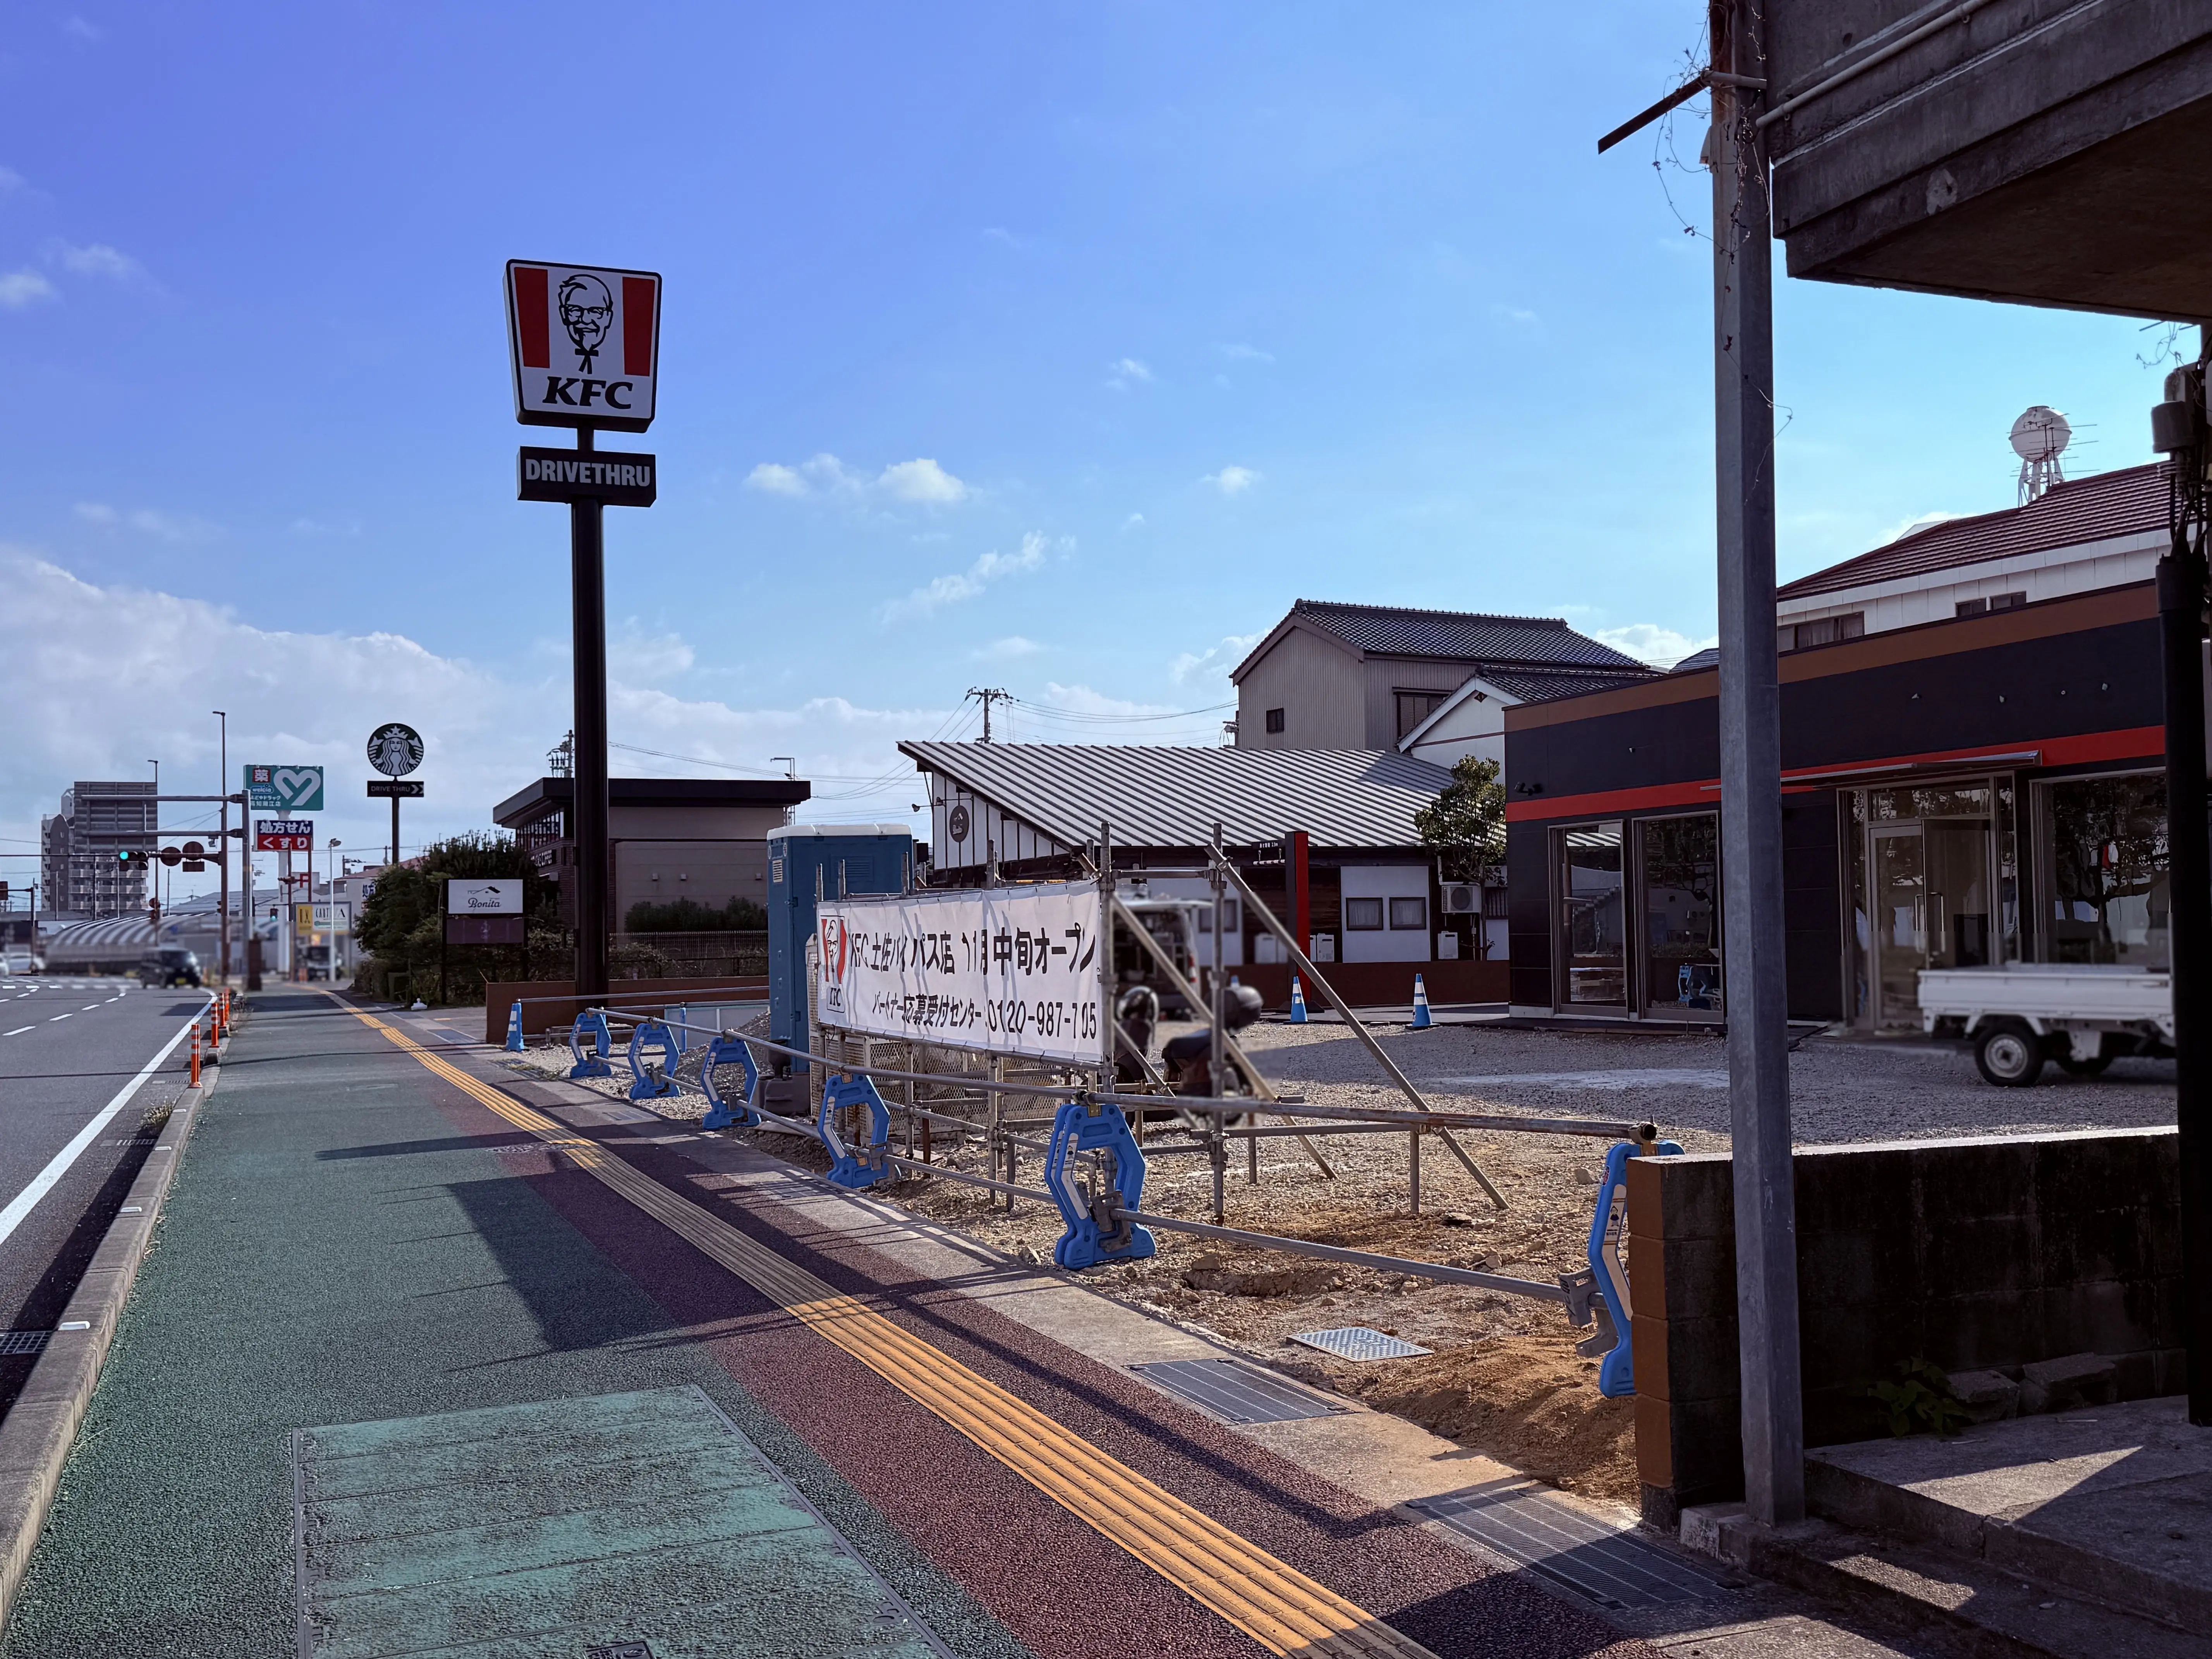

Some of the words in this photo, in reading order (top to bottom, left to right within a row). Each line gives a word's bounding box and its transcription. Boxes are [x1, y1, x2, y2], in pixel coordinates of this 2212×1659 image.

[542, 376, 633, 409] KFC
[525, 459, 651, 487] DRIVETHRU
[260, 821, 310, 833] 処方せん
[263, 837, 307, 848] くすり
[468, 898, 501, 908] Bonita
